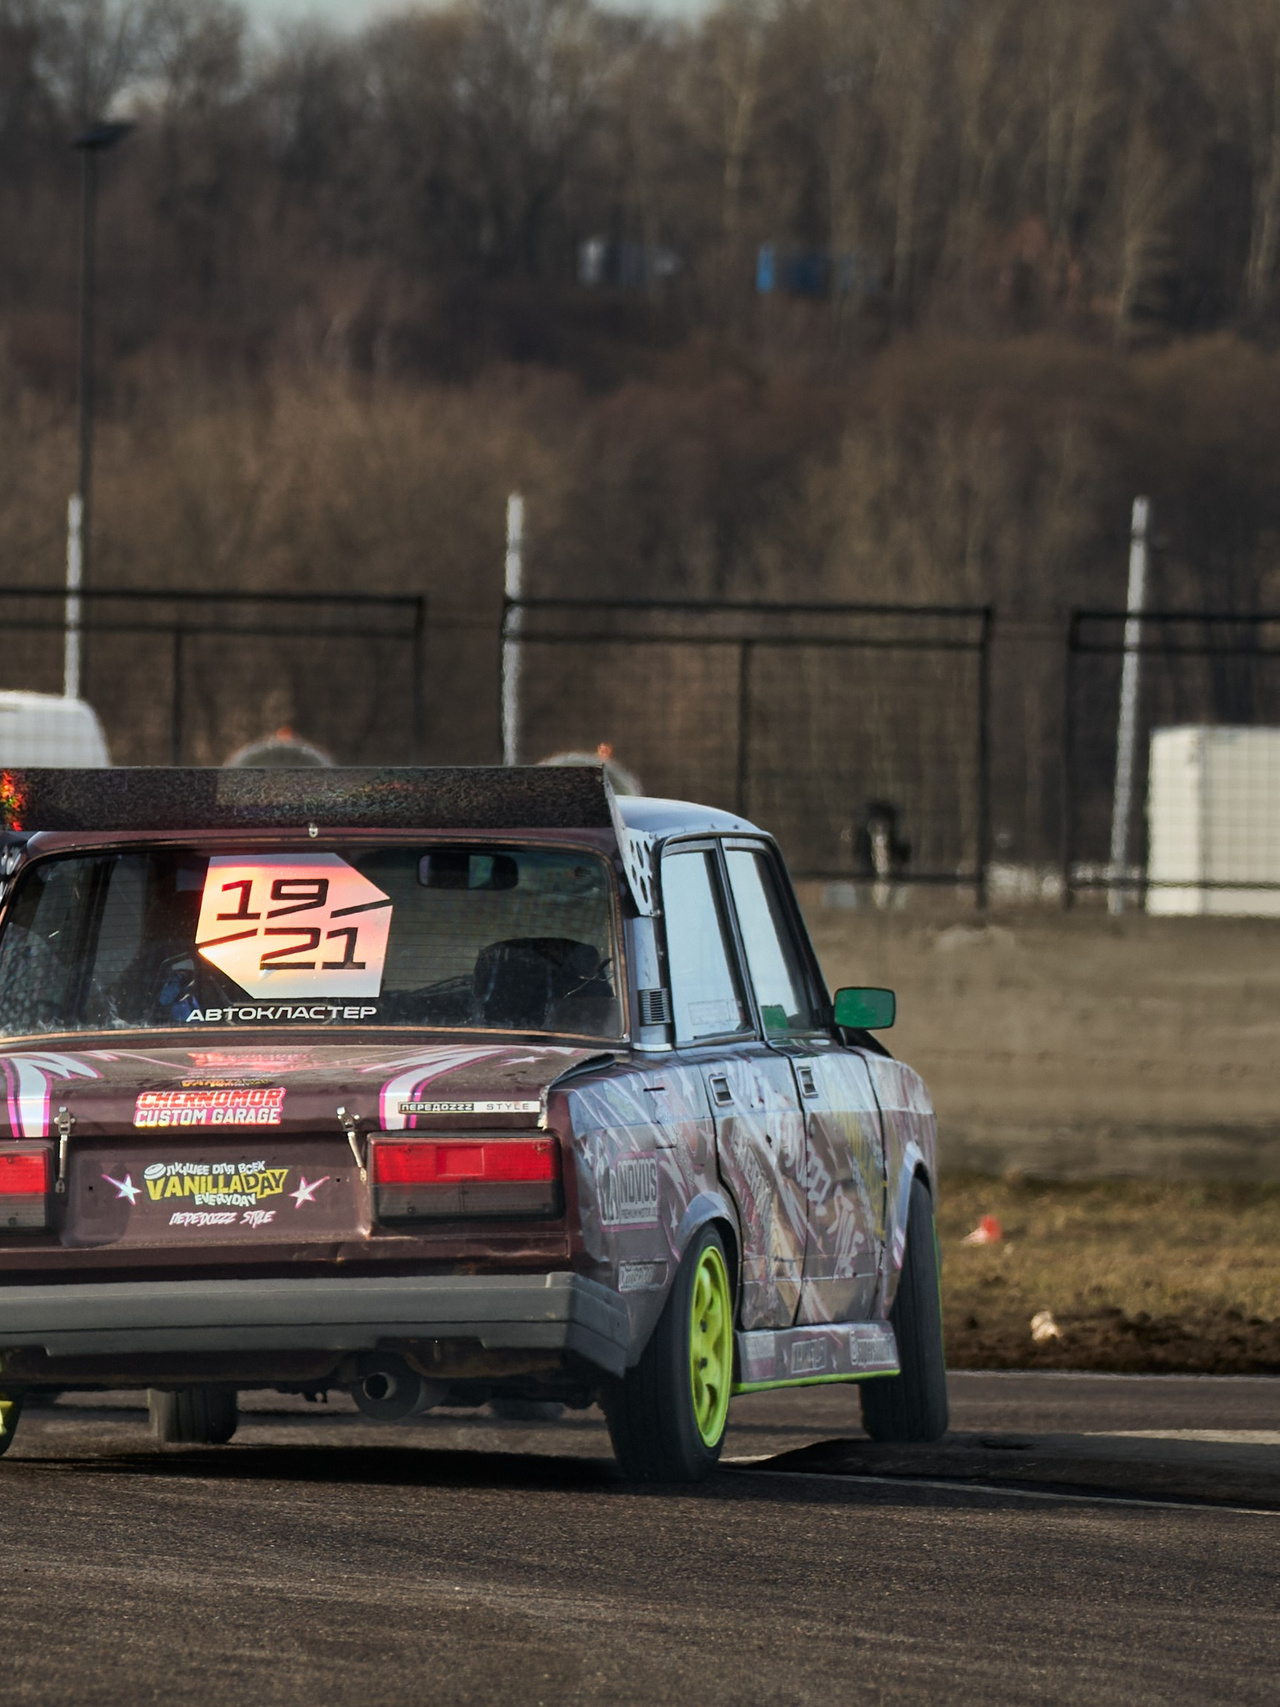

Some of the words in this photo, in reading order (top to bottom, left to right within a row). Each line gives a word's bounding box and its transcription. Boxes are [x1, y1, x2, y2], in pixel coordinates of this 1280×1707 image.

[216, 878, 329, 921] 19
[259, 927, 366, 970] 21
[186, 1006, 377, 1022] АВТОКЛАСТЕР
[138, 1088, 285, 1109] CHERNOMOR
[486, 1103, 530, 1111] STYLE
[135, 1108, 207, 1127] CUSTOM
[211, 1108, 282, 1125] GARAGE
[618, 1160, 658, 1204] NOVUS
[194, 1192, 257, 1207] EVERYDAY
[240, 1210, 276, 1229] STYLE
